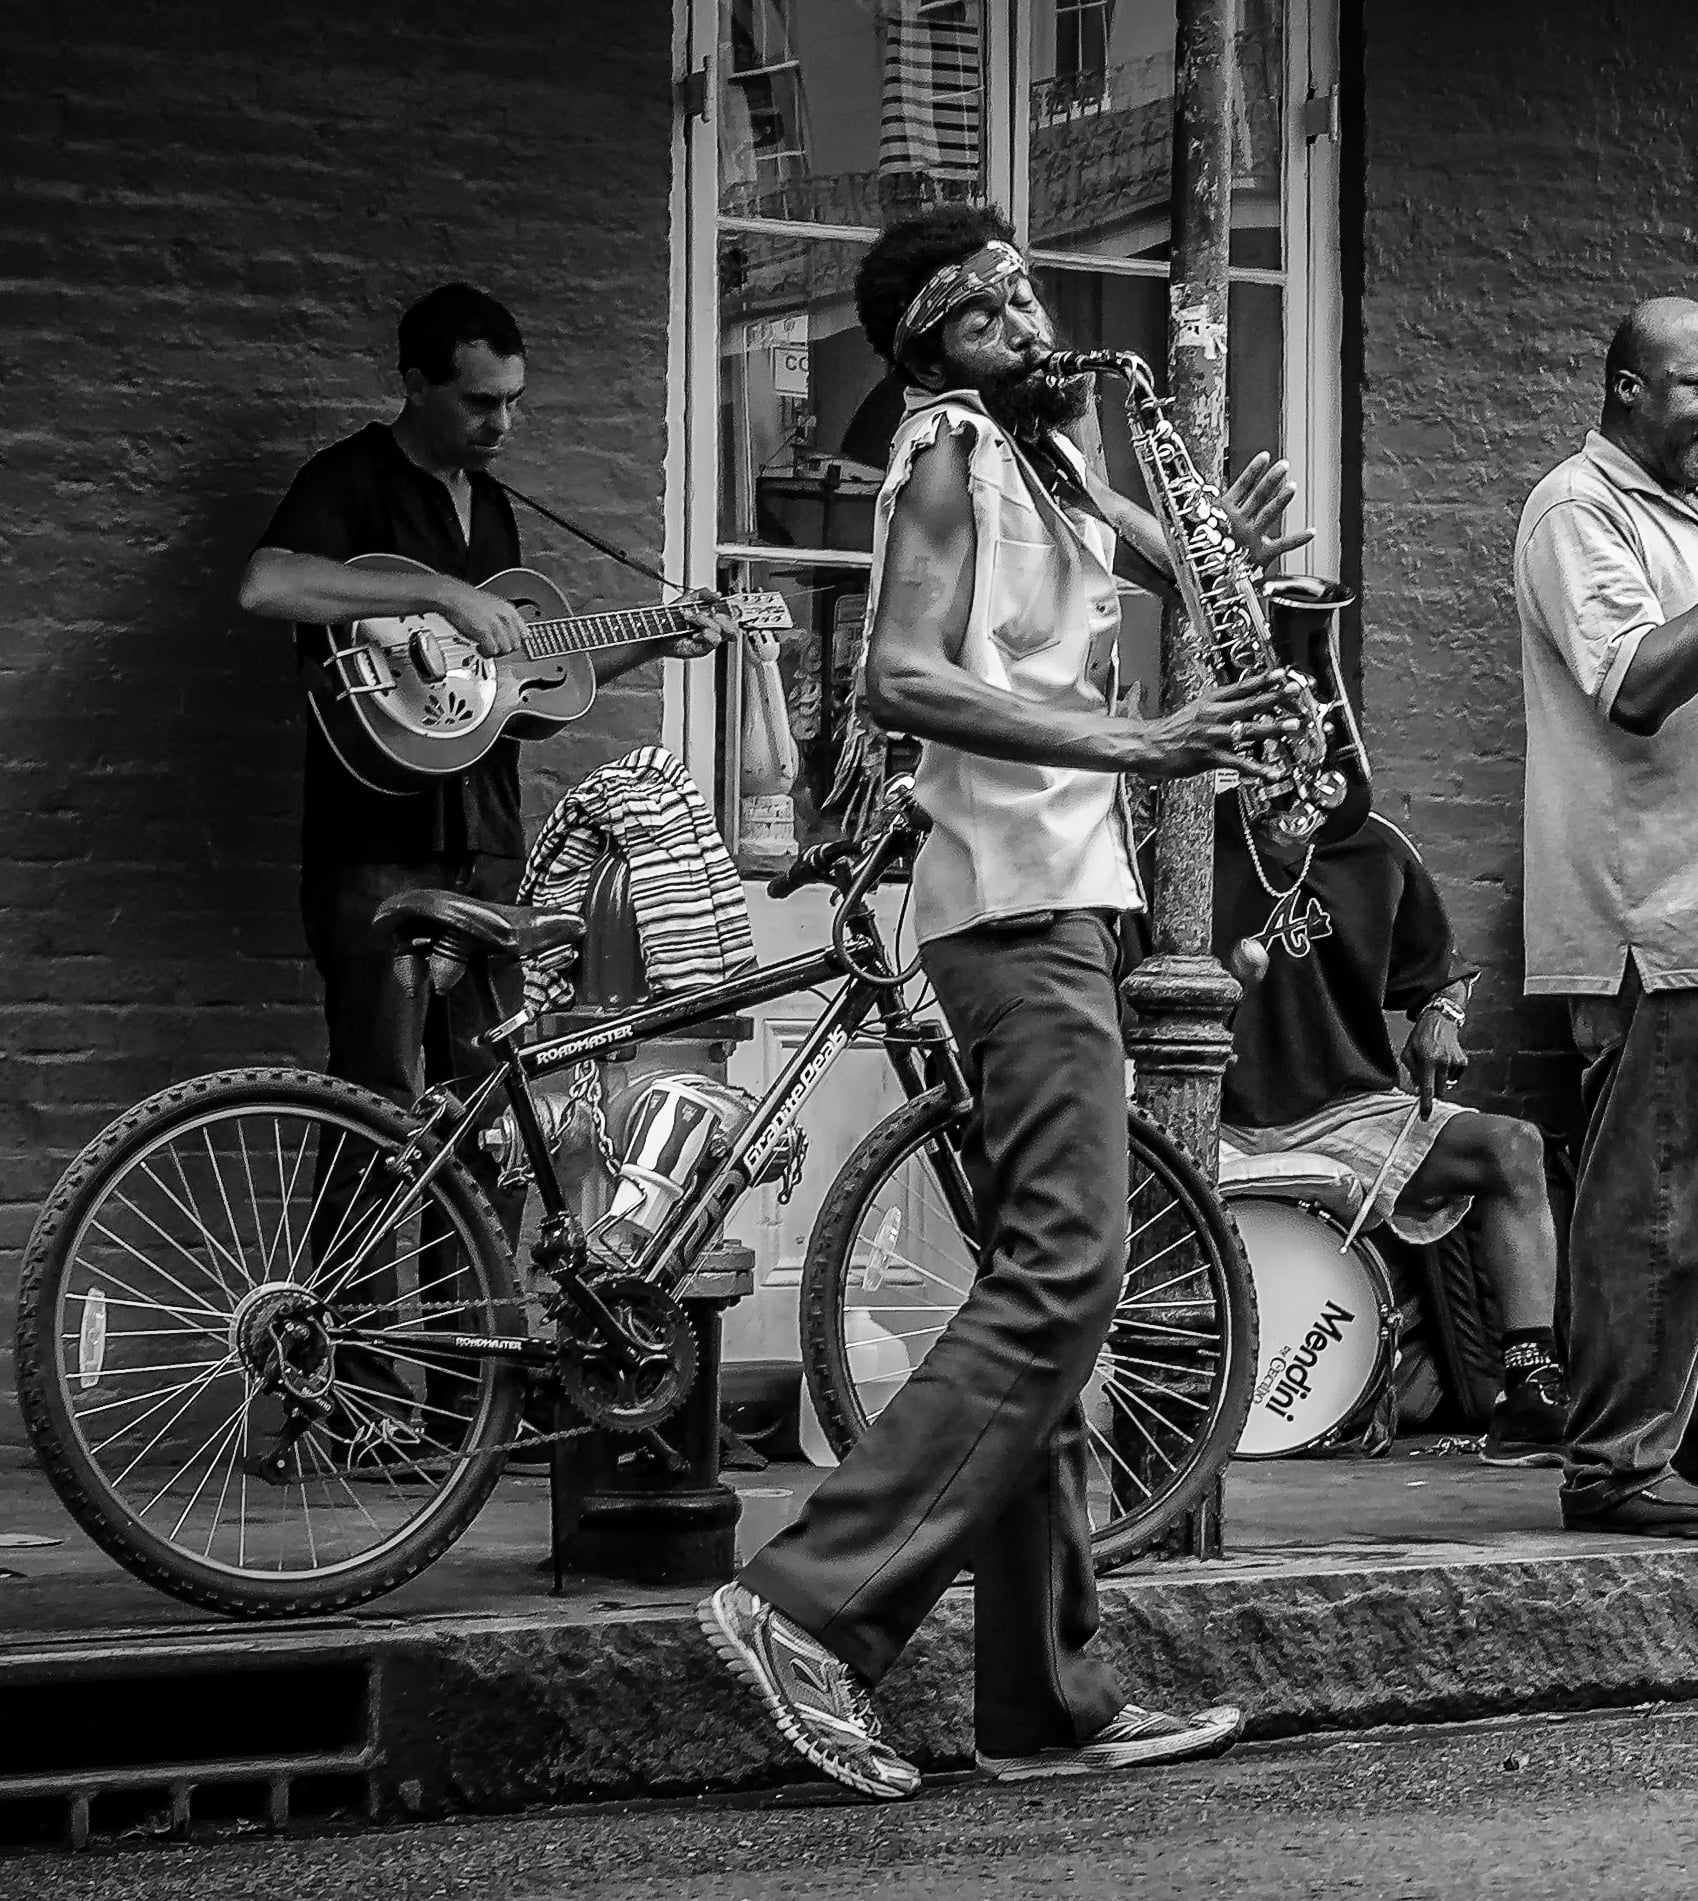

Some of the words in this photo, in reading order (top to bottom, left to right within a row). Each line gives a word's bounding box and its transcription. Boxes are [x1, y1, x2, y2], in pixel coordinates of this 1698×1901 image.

[536, 1025, 633, 1065] ROADMASTER
[455, 1336, 522, 1351] ROADMASTER
[1265, 1299, 1355, 1422] Mendini
